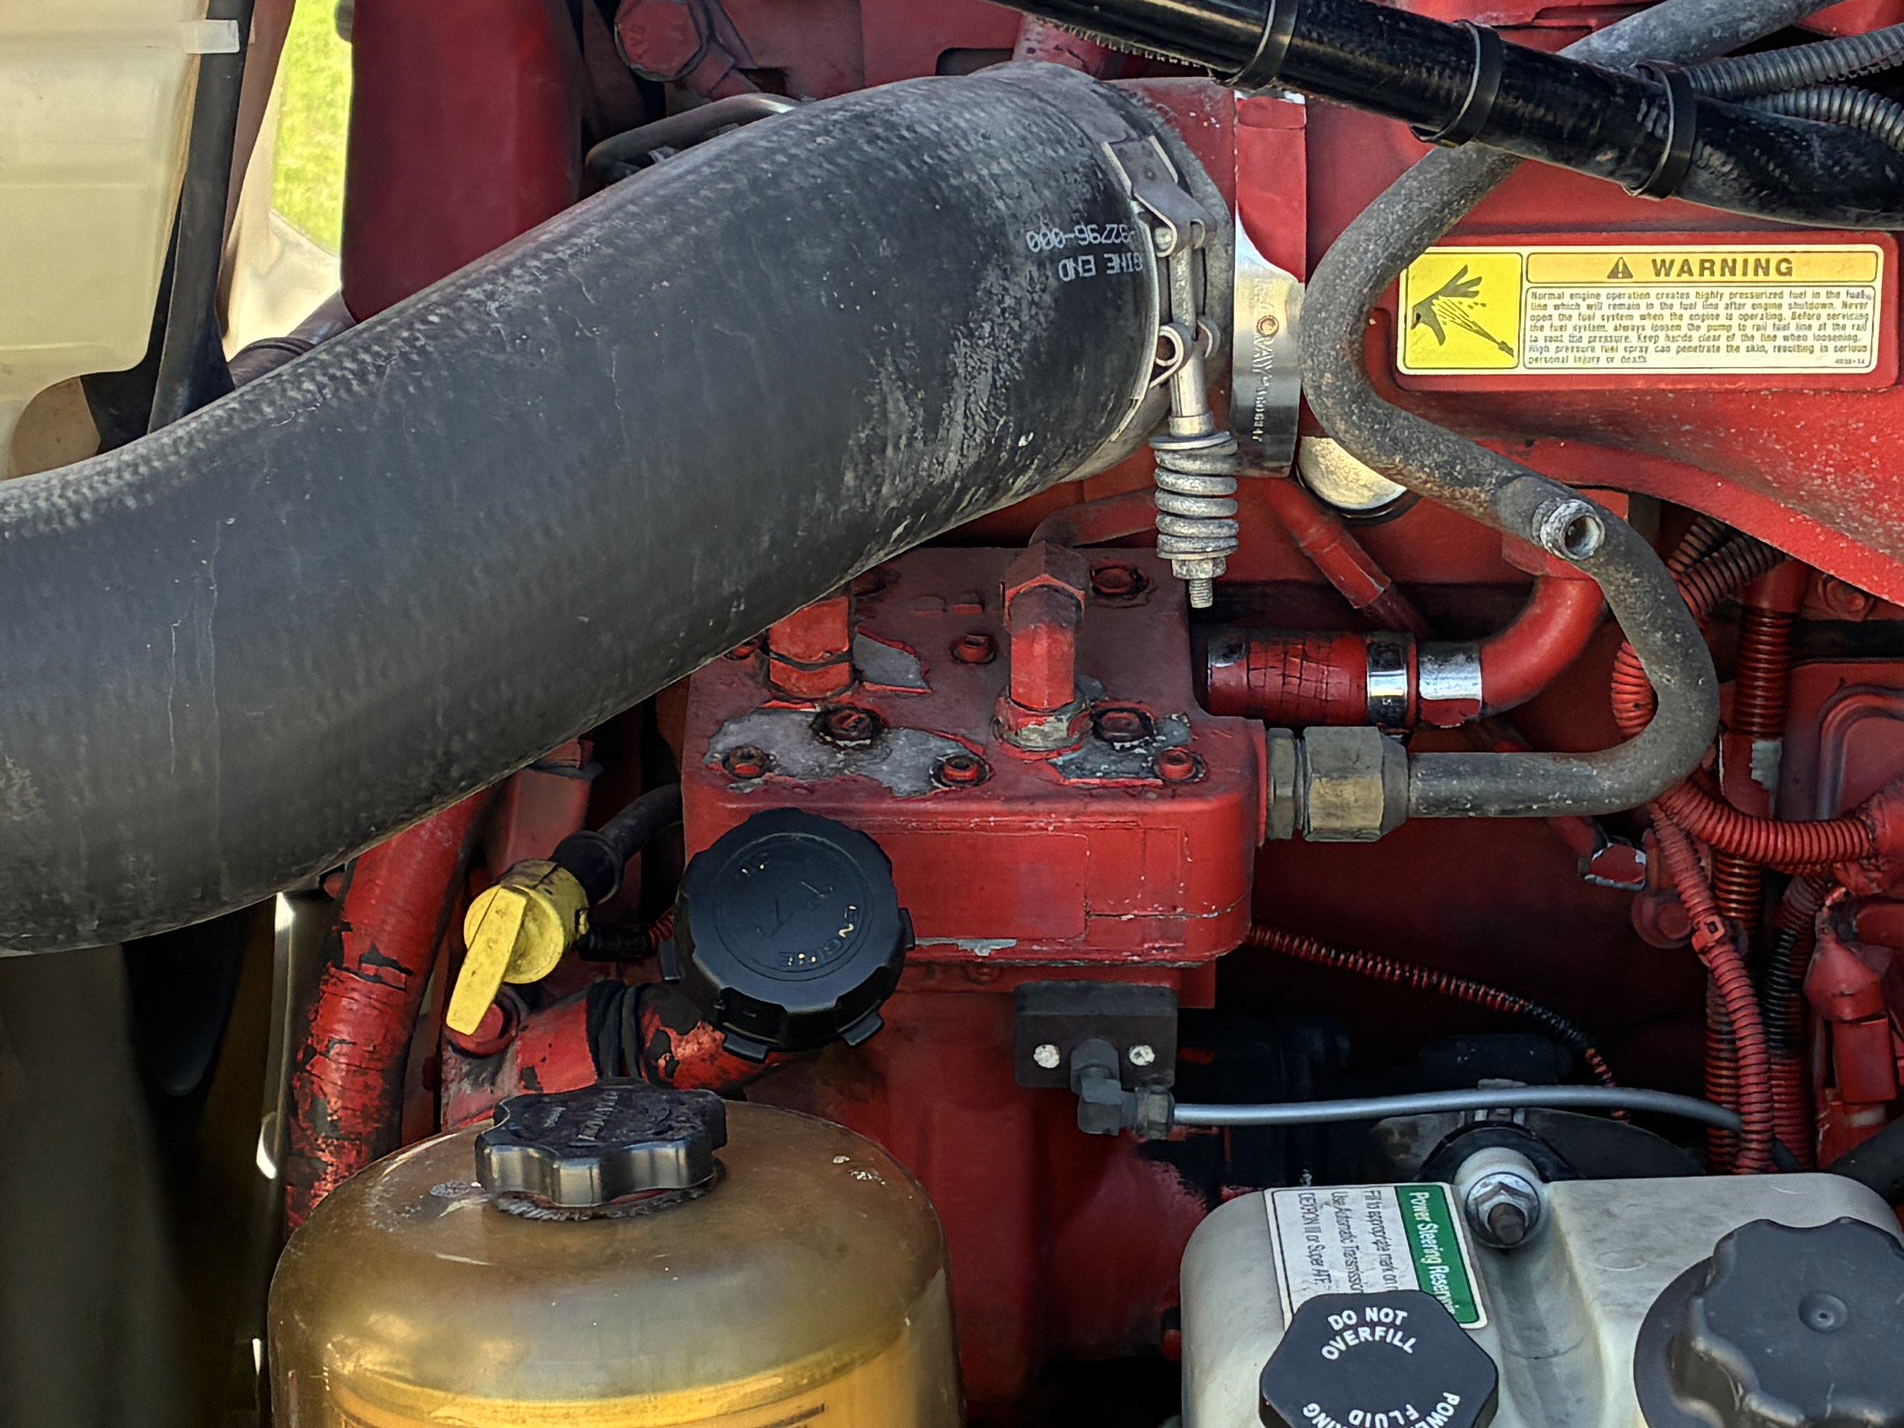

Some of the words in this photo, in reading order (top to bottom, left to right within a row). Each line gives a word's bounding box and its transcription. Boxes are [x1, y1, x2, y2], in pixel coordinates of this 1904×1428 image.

[1059, 255, 1096, 282] END
[1652, 258, 1793, 277] WARNING
[1531, 292, 1564, 300] Normal
[1570, 293, 1601, 301] engine
[1606, 292, 1650, 301] operation
[1656, 292, 1690, 300] creates
[1695, 290, 1724, 301] highly
[1729, 290, 1783, 300] pressurized
[1554, 302, 1580, 310] which
[1608, 302, 1640, 310] remain
[1724, 301, 1746, 310] after
[1752, 302, 1782, 311] engine
[1841, 301, 1868, 310] Never
[1601, 313, 1633, 322] system
[1639, 313, 1664, 321] when
[1689, 313, 1719, 322] engine
[1707, 324, 1732, 332] pump
[1637, 334, 1659, 344] Keep
[1698, 334, 1720, 342] clear
[1783, 333, 1807, 341] when
[1409, 1192, 1432, 1221] Power
[1417, 1223, 1444, 1265] Steering
[1328, 1310, 1358, 1331] DO
[1365, 1307, 1408, 1326] NOT
[1321, 1325, 1418, 1360] OVERFILL
